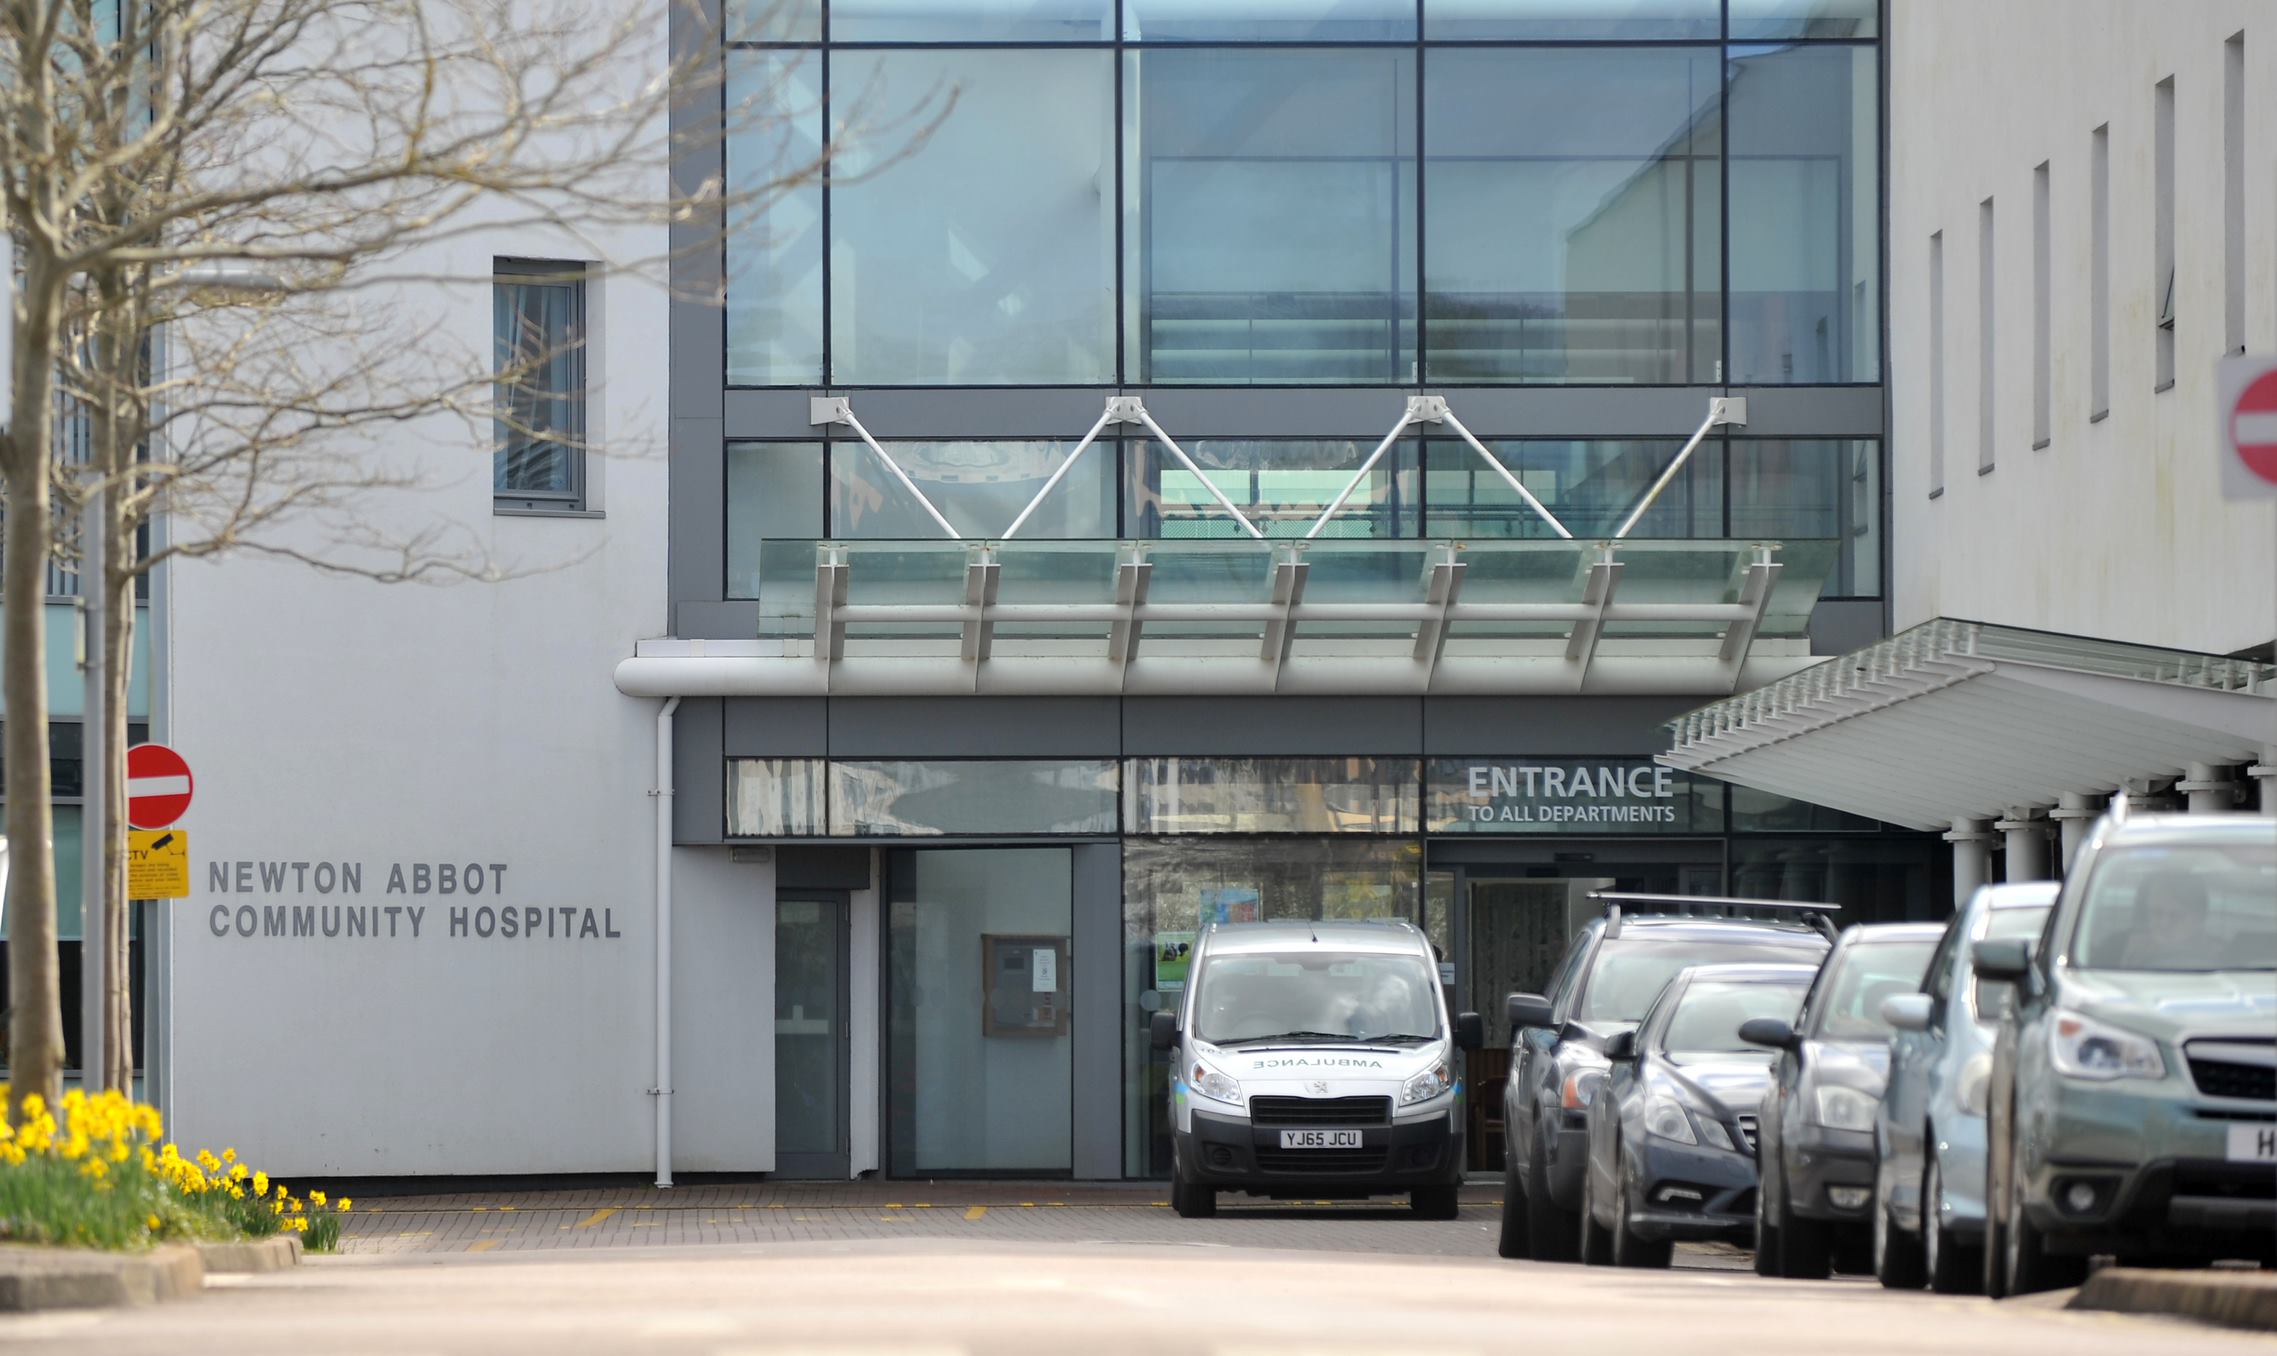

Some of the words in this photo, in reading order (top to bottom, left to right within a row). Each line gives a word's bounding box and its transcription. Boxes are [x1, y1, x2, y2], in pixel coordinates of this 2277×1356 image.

[1469, 767, 1674, 797] ENTRANCE
[1468, 805, 1495, 823] TO
[1500, 805, 1534, 823] ALL
[1539, 805, 1675, 823] DEPARTMENTS
[208, 861, 362, 894] NEWTON
[386, 863, 508, 895] ABBOT
[208, 904, 426, 938] COMMUNITY
[449, 906, 621, 939] HOSPITAL
[1286, 1133, 1324, 1146] YJ65
[1329, 1133, 1357, 1146] JCU
